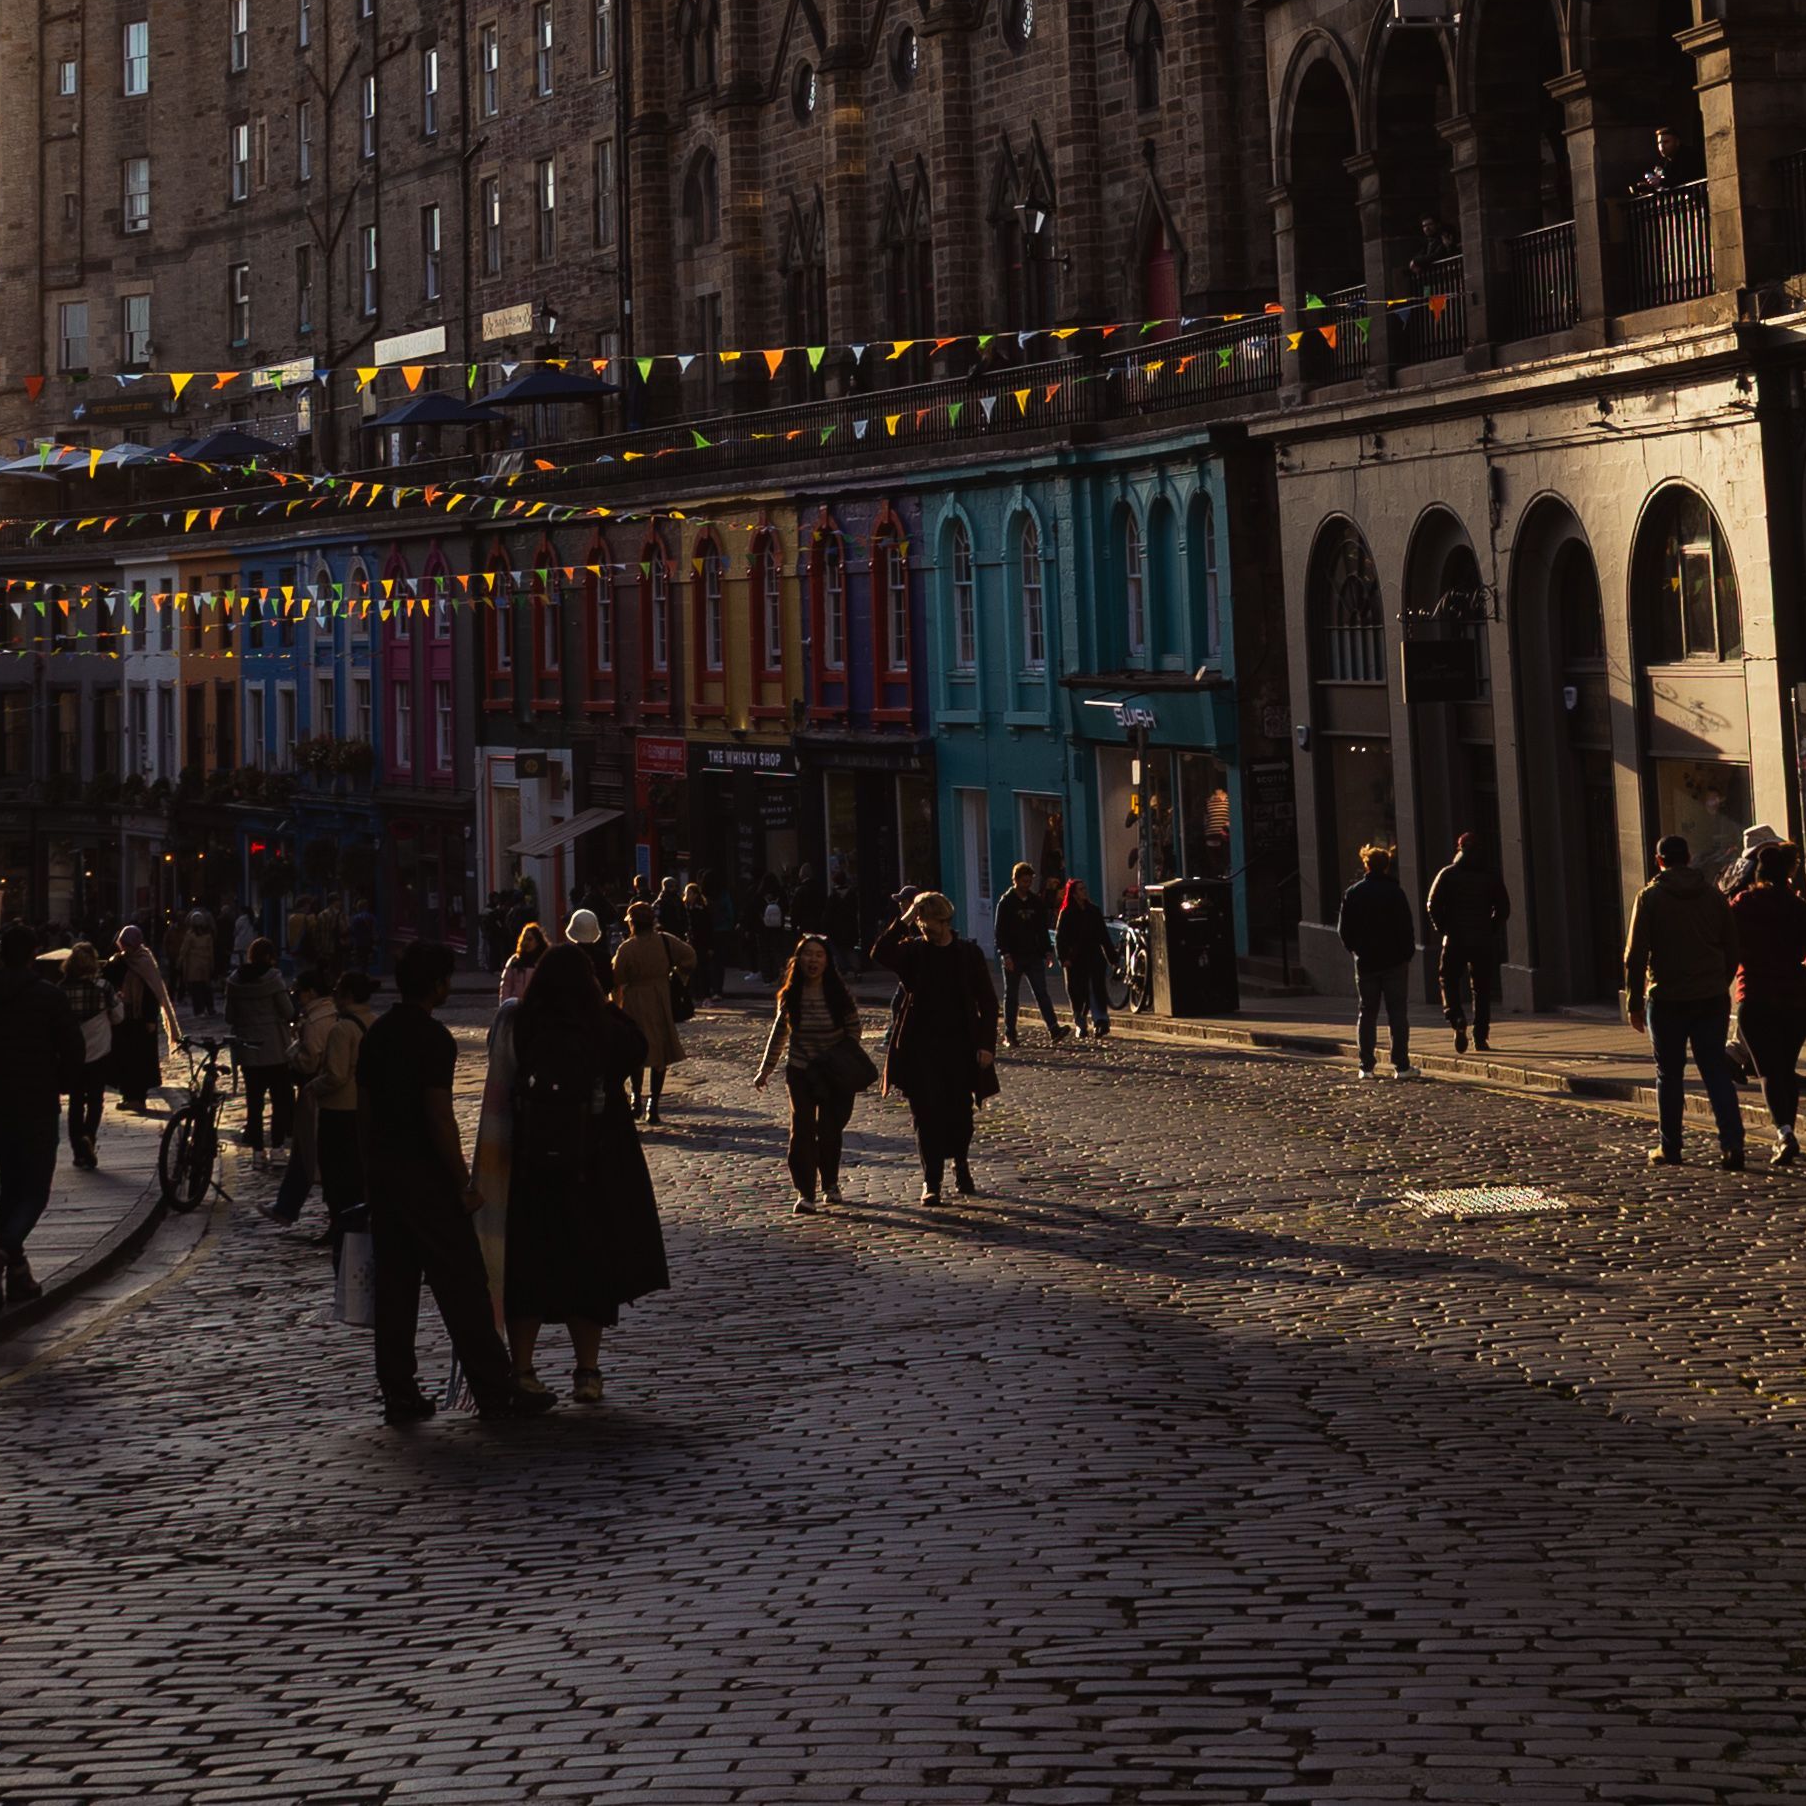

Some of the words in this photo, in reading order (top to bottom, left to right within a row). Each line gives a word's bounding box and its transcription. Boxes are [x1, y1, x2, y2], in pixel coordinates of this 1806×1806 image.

[1113, 707, 1157, 729] SWISH
[707, 750, 724, 763] THE
[725, 750, 757, 766] WHISKY
[759, 752, 782, 767] SHOP
[767, 795, 784, 803] THE
[759, 806, 793, 815] WHISKY
[765, 818, 787, 826] SHOP
